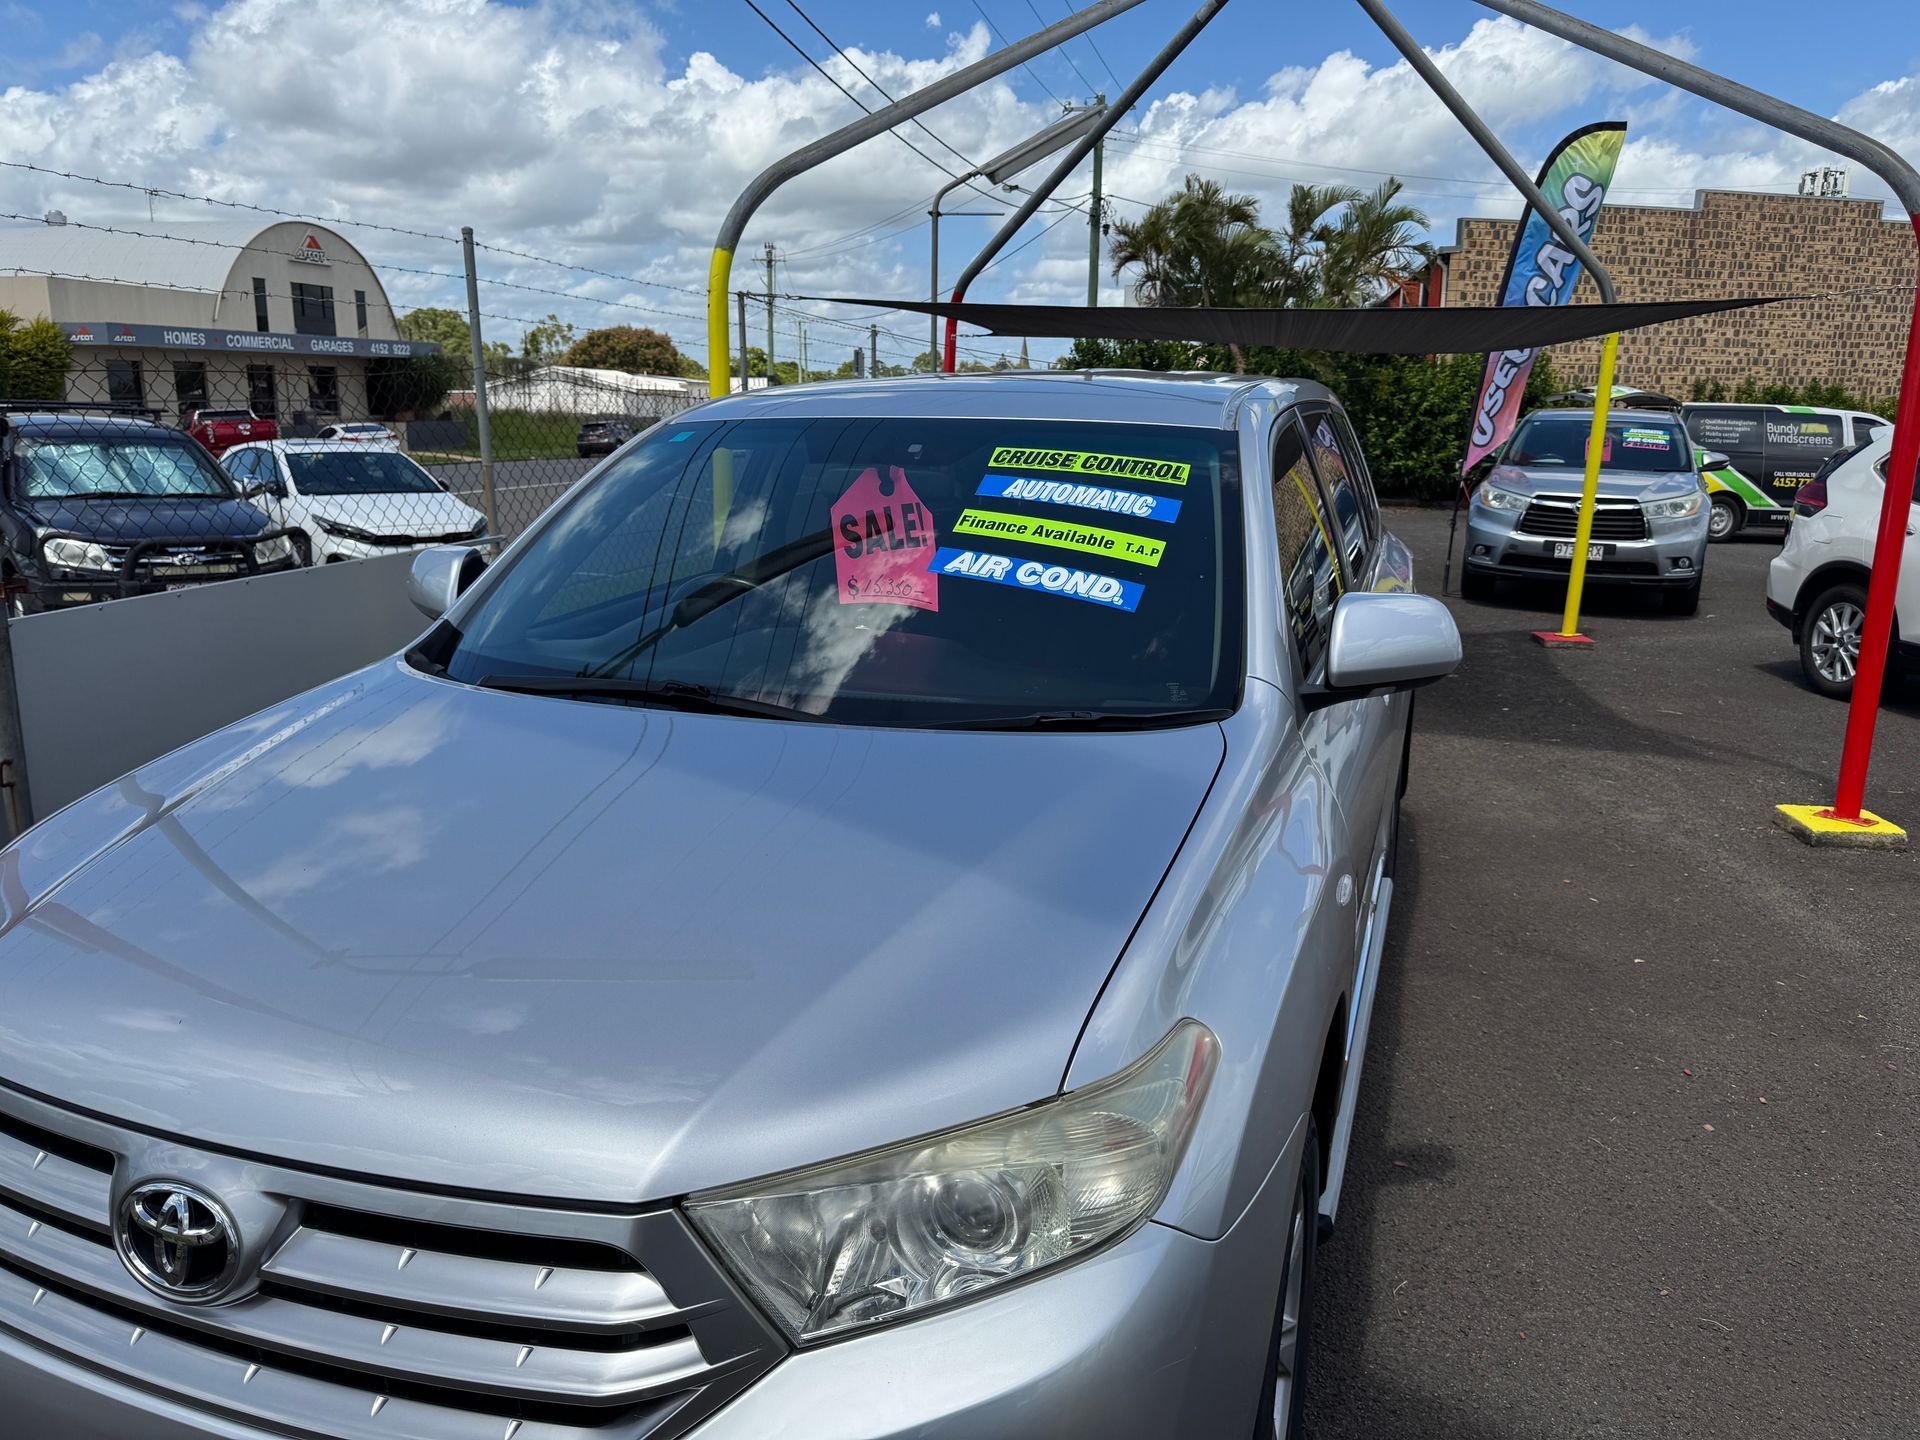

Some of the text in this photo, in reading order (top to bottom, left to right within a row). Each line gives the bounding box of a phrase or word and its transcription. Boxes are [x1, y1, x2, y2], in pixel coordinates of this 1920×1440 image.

[164, 330, 411, 355] HOMES COMMERCIAL GARAGES 4152 9222
[1766, 422, 1799, 435] Bundy
[1767, 433, 1834, 445] Windscreens
[992, 449, 1186, 482] CRUISE CONTROL
[1772, 477, 1797, 487] 4152
[1001, 478, 1157, 517] AUTOMATIC
[839, 502, 929, 559] SALE!
[957, 514, 1160, 557] Finance Available T.A.P
[943, 551, 1124, 605] AIR COND.
